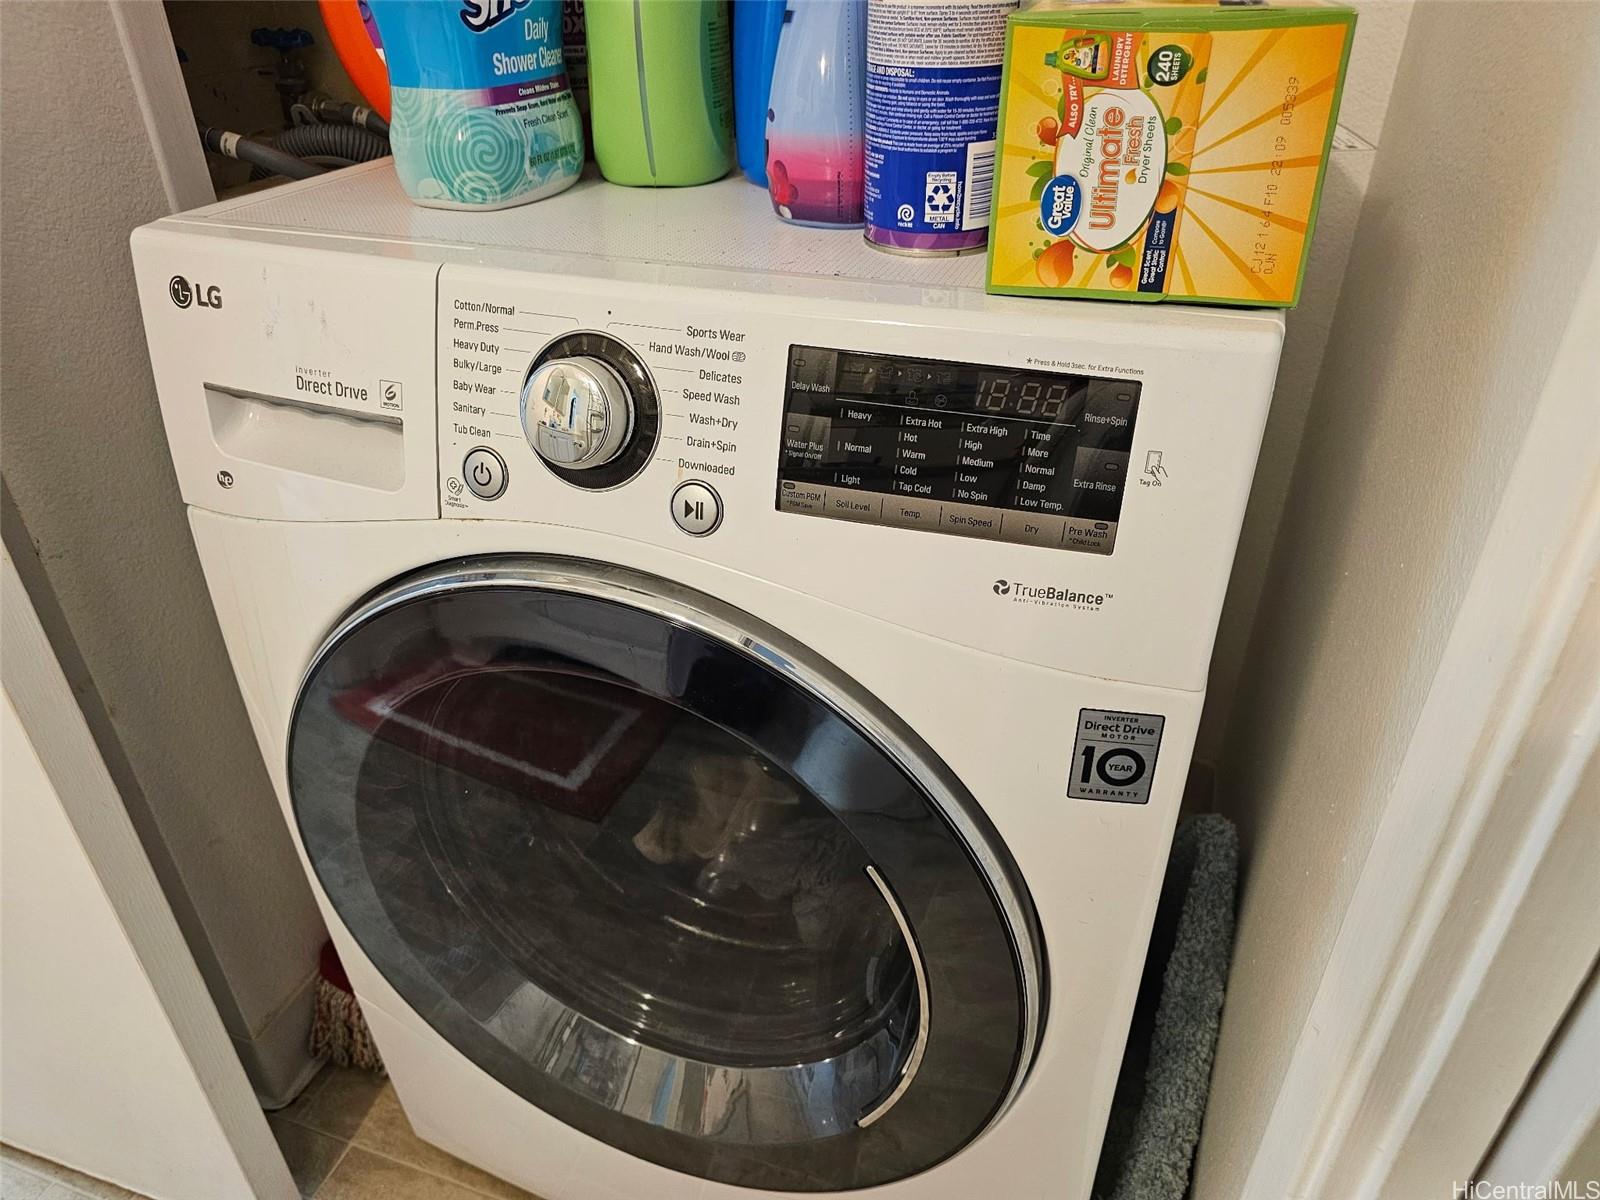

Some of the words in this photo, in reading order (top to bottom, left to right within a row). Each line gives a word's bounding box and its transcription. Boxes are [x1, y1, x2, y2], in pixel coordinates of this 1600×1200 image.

[525, 18, 549, 43] Daily
[492, 53, 538, 76] Shower
[1112, 37, 1125, 82] LAUNDRY
[1119, 32, 1134, 86] DETERGENT
[1156, 50, 1173, 83] 240
[1170, 52, 1182, 81] SHEETS
[886, 67, 915, 78] DISPOSAL:
[518, 86, 535, 96] Cleans
[495, 105, 516, 116] Prevents
[516, 103, 528, 112] Soap
[1069, 97, 1080, 129] ALSO
[523, 117, 542, 129] Fresh
[542, 113, 557, 124] Clean
[1086, 106, 1098, 136] Clean
[1122, 115, 1145, 166] Fresh
[1143, 115, 1157, 153] Sheets
[1079, 138, 1096, 180] Original
[1089, 106, 1126, 231] Ultimate
[1137, 154, 1151, 184] Dryer
[1048, 185, 1066, 230] Great
[1061, 186, 1076, 221] Value
[1152, 220, 1161, 245] Compare
[1151, 250, 1159, 266] Static
[1141, 267, 1149, 284] Great
[1148, 266, 1156, 283] Great
[195, 283, 223, 309] LG
[454, 299, 515, 316] Cotton/Normal
[453, 318, 499, 333] Perm.Press
[686, 325, 718, 339] Sports
[719, 329, 746, 342] Wear
[453, 338, 479, 352] Heavy
[480, 341, 500, 355] Duty
[649, 342, 673, 354] Hand
[674, 344, 730, 361] Wash/Wool
[296, 365, 331, 378] inverter
[453, 358, 502, 375] Bulky/Large
[1034, 358, 1050, 367] Press
[1057, 360, 1071, 368] Hold
[1087, 363, 1097, 371] for
[1097, 364, 1114, 373] Extra
[1114, 365, 1144, 376] Functions
[699, 369, 742, 384] Delicates
[296, 376, 332, 396] Direct
[335, 381, 368, 401] Drive
[453, 380, 473, 393] Baby
[475, 383, 496, 395] Wear
[791, 381, 810, 392] Delay
[811, 383, 831, 393] Wash
[682, 388, 712, 402] Speed
[714, 392, 740, 405] Wash
[453, 401, 486, 417] Sanitary
[847, 410, 872, 422] Heavy
[689, 413, 738, 431] Wash+Dry
[905, 416, 927, 427] Extra
[928, 418, 942, 429] Hot
[1084, 413, 1128, 428] Rinse+Spin
[453, 423, 468, 434] Tub
[469, 425, 491, 438] Clean
[904, 432, 918, 443] Hot
[966, 424, 988, 434] Extra
[989, 426, 1008, 437] High
[1031, 430, 1051, 441] Time
[686, 436, 737, 453] Drain+Spin
[786, 439, 808, 450] Water
[808, 441, 824, 452] Plus
[844, 442, 872, 453] Normal
[964, 440, 983, 451] High
[804, 452, 822, 460] On/Off
[902, 449, 926, 460] Warm
[1027, 447, 1049, 458] More
[678, 458, 736, 476] Downloaded
[962, 456, 994, 468] Medium
[900, 465, 917, 476] Cold
[960, 472, 978, 483] Low
[1025, 464, 1055, 476] Normal
[841, 474, 861, 485] Light
[1022, 480, 1046, 493] Damp
[1073, 479, 1094, 490] Extra
[1096, 481, 1117, 492] Rinse
[1139, 479, 1150, 487] Tag
[782, 489, 805, 500] Custom
[805, 493, 821, 501] PGM
[899, 482, 913, 493] Tap
[914, 484, 931, 494] Cold
[957, 489, 969, 499] No
[970, 490, 988, 502] Spin
[836, 500, 849, 509] Soil
[850, 501, 870, 512] Level
[1020, 497, 1038, 507] Low
[1040, 499, 1064, 511] Temp.
[900, 508, 922, 519] Temp.
[949, 515, 966, 526] Spin
[967, 517, 993, 528] Speed
[1025, 524, 1039, 535] Dry
[1069, 527, 1083, 536] Pre
[1084, 528, 1108, 539] Wash
[1072, 538, 1087, 546] Child
[1013, 597, 1069, 609] Anti-Vibration
[1073, 604, 1100, 612] System
[1104, 715, 1139, 723] INVERTER
[1084, 721, 1120, 732] Direct
[1123, 725, 1155, 735] Drive
[1081, 745, 1146, 787] 10
[1108, 763, 1133, 772] YEAR
[1080, 787, 1138, 797] WARRANTY
